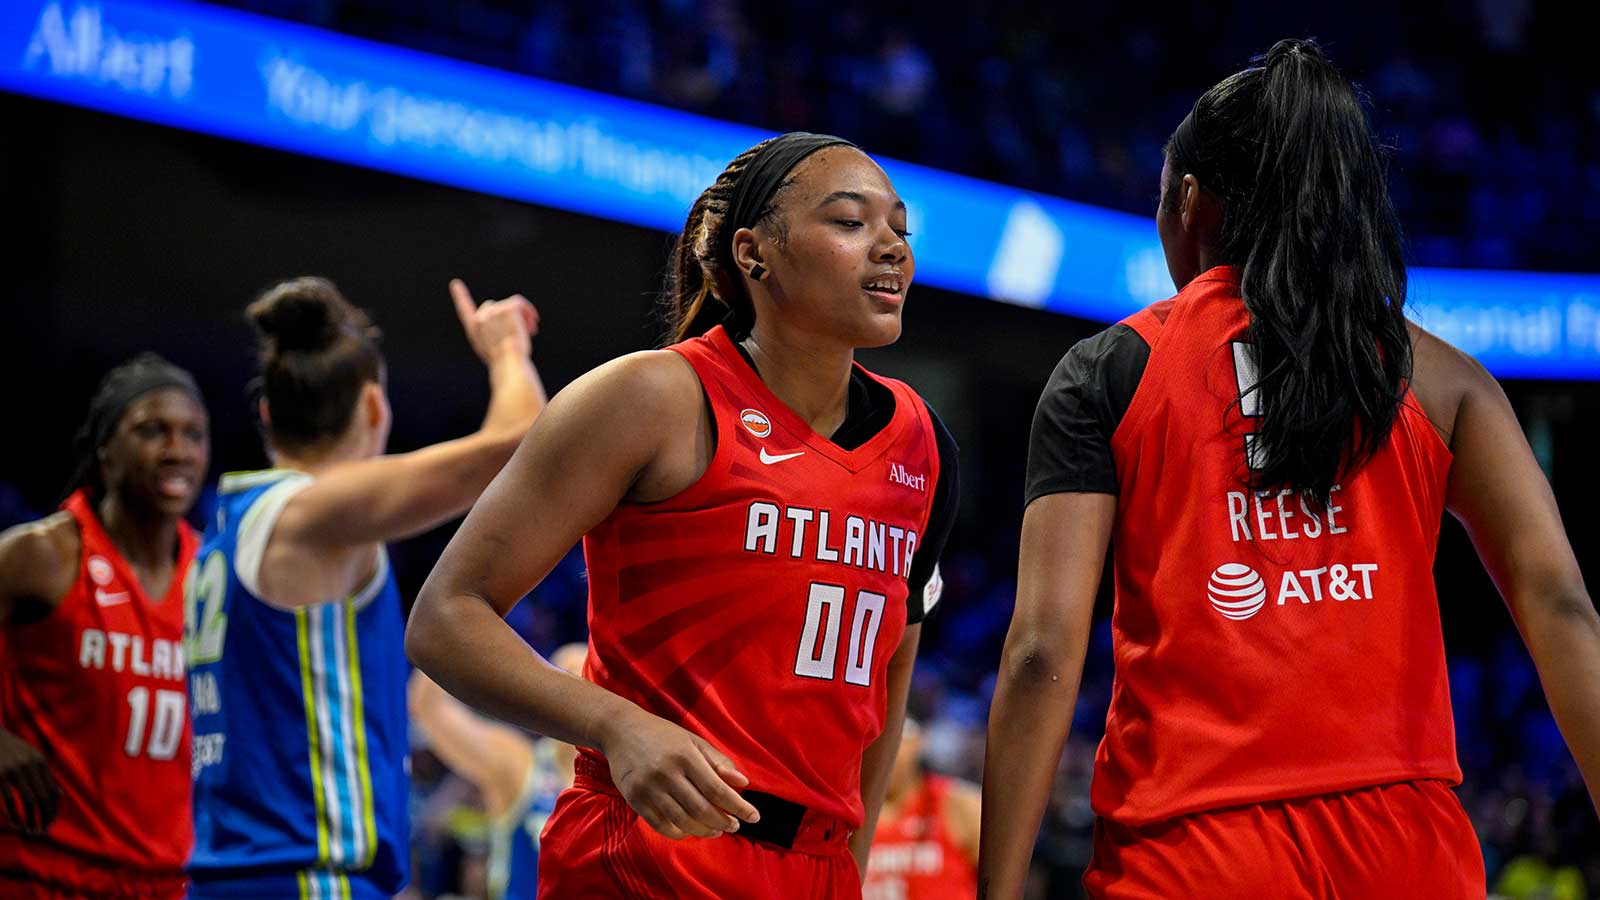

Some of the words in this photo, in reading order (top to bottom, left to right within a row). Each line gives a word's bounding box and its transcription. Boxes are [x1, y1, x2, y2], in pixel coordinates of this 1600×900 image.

[889, 462, 925, 492] Albert
[744, 501, 917, 579] ATLANTA
[1227, 485, 1347, 542] REESE
[1277, 563, 1378, 605] AT&T
[794, 582, 886, 687] 00
[125, 686, 186, 760] 10
